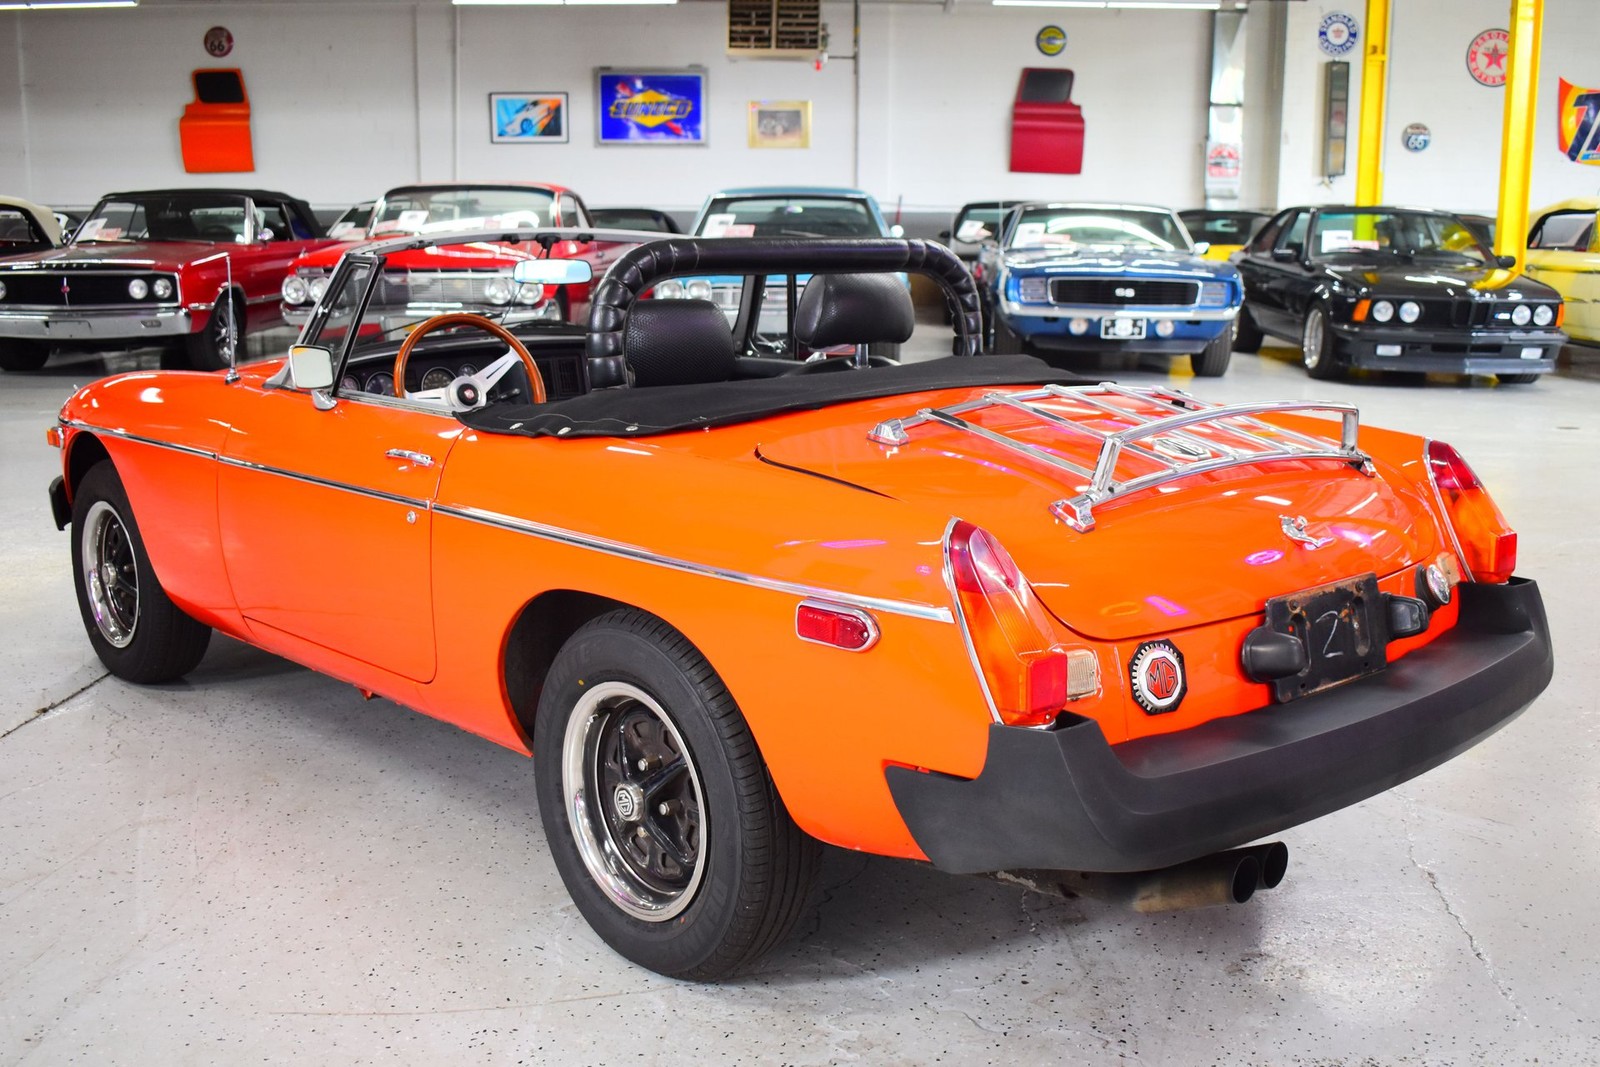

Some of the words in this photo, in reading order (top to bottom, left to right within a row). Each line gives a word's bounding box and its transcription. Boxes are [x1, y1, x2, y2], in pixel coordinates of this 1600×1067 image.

[1319, 13, 1357, 32] STANDARD
[210, 40, 225, 52] 66
[1319, 36, 1356, 55] GASOLINE
[1471, 31, 1509, 50] GASOL
[611, 100, 690, 117] SUNOCO
[1407, 133, 1426, 150] 66
[1146, 656, 1178, 699] MG
[618, 790, 633, 815] MG
